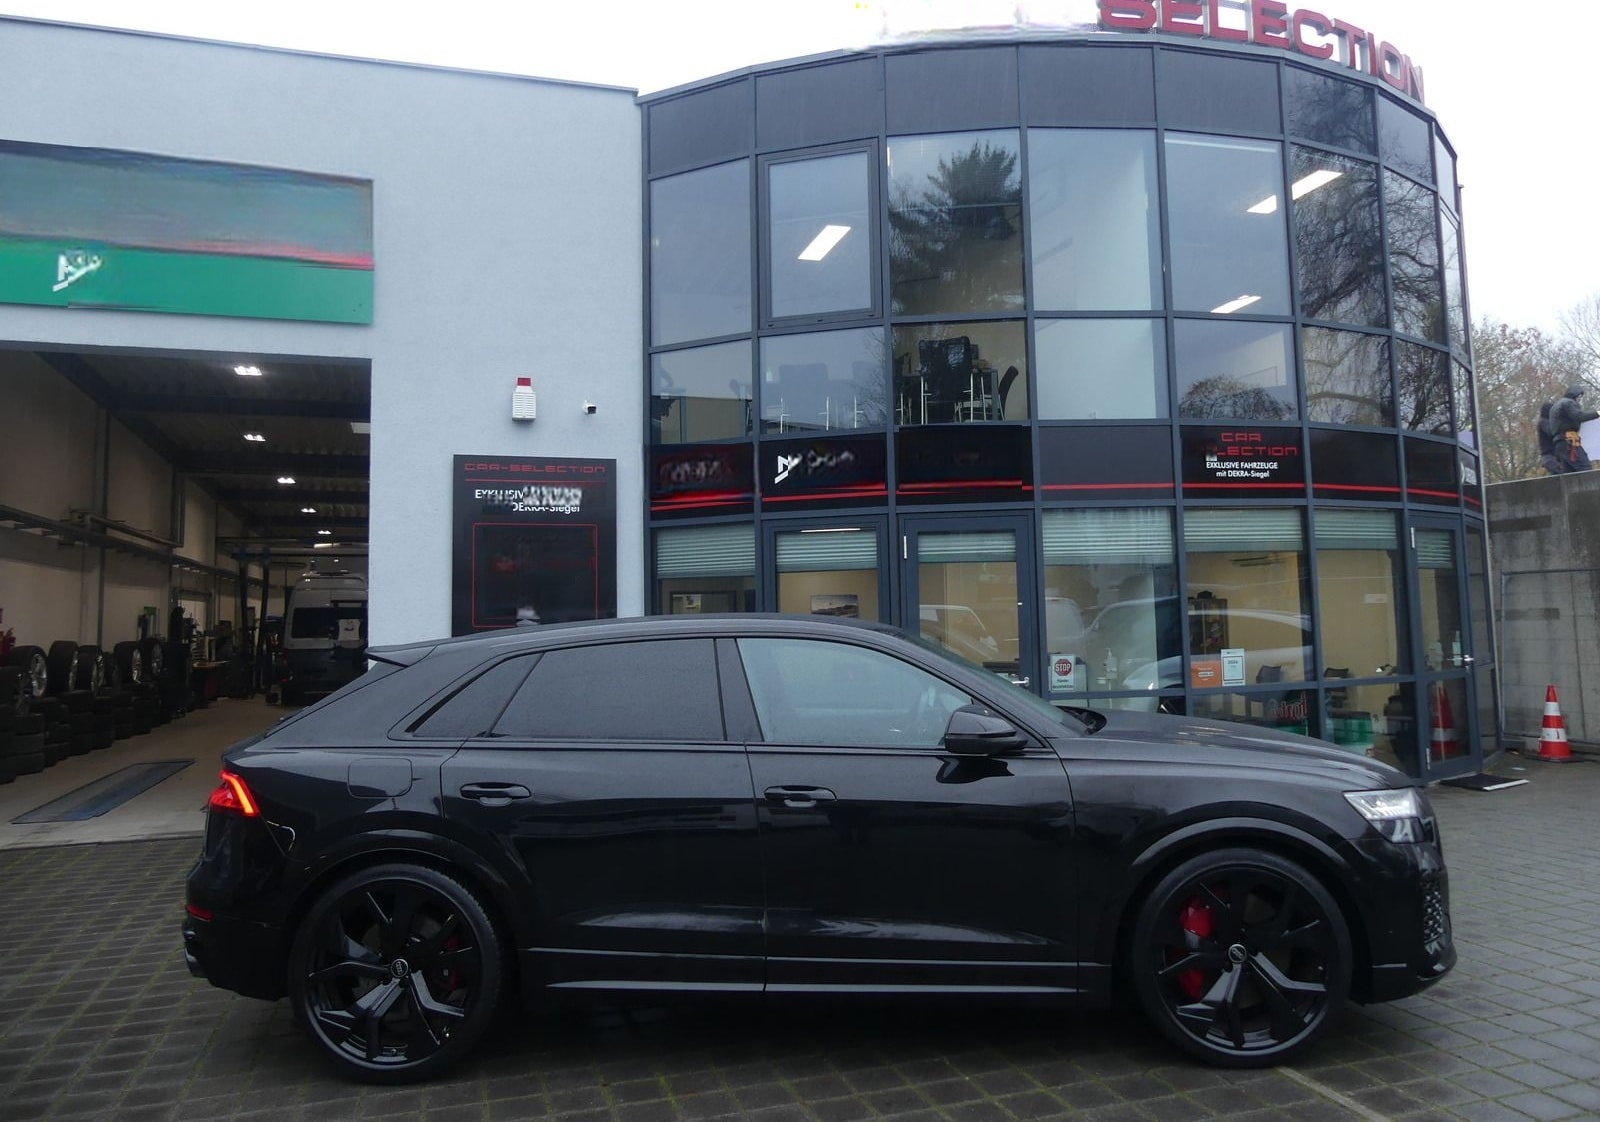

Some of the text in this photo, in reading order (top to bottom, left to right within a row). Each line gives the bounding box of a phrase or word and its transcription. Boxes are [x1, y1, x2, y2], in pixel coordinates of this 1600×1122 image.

[1098, 0, 1424, 103] SELECTION
[1221, 432, 1261, 442] CAR
[1216, 446, 1297, 456] ECTION
[464, 463, 605, 473] CAR-SELECTION
[1206, 461, 1278, 469] EXKLUSIVE FAHRZEUGE
[1227, 470, 1270, 479] DEKRA-Siegel
[1055, 663, 1072, 672] STOP
